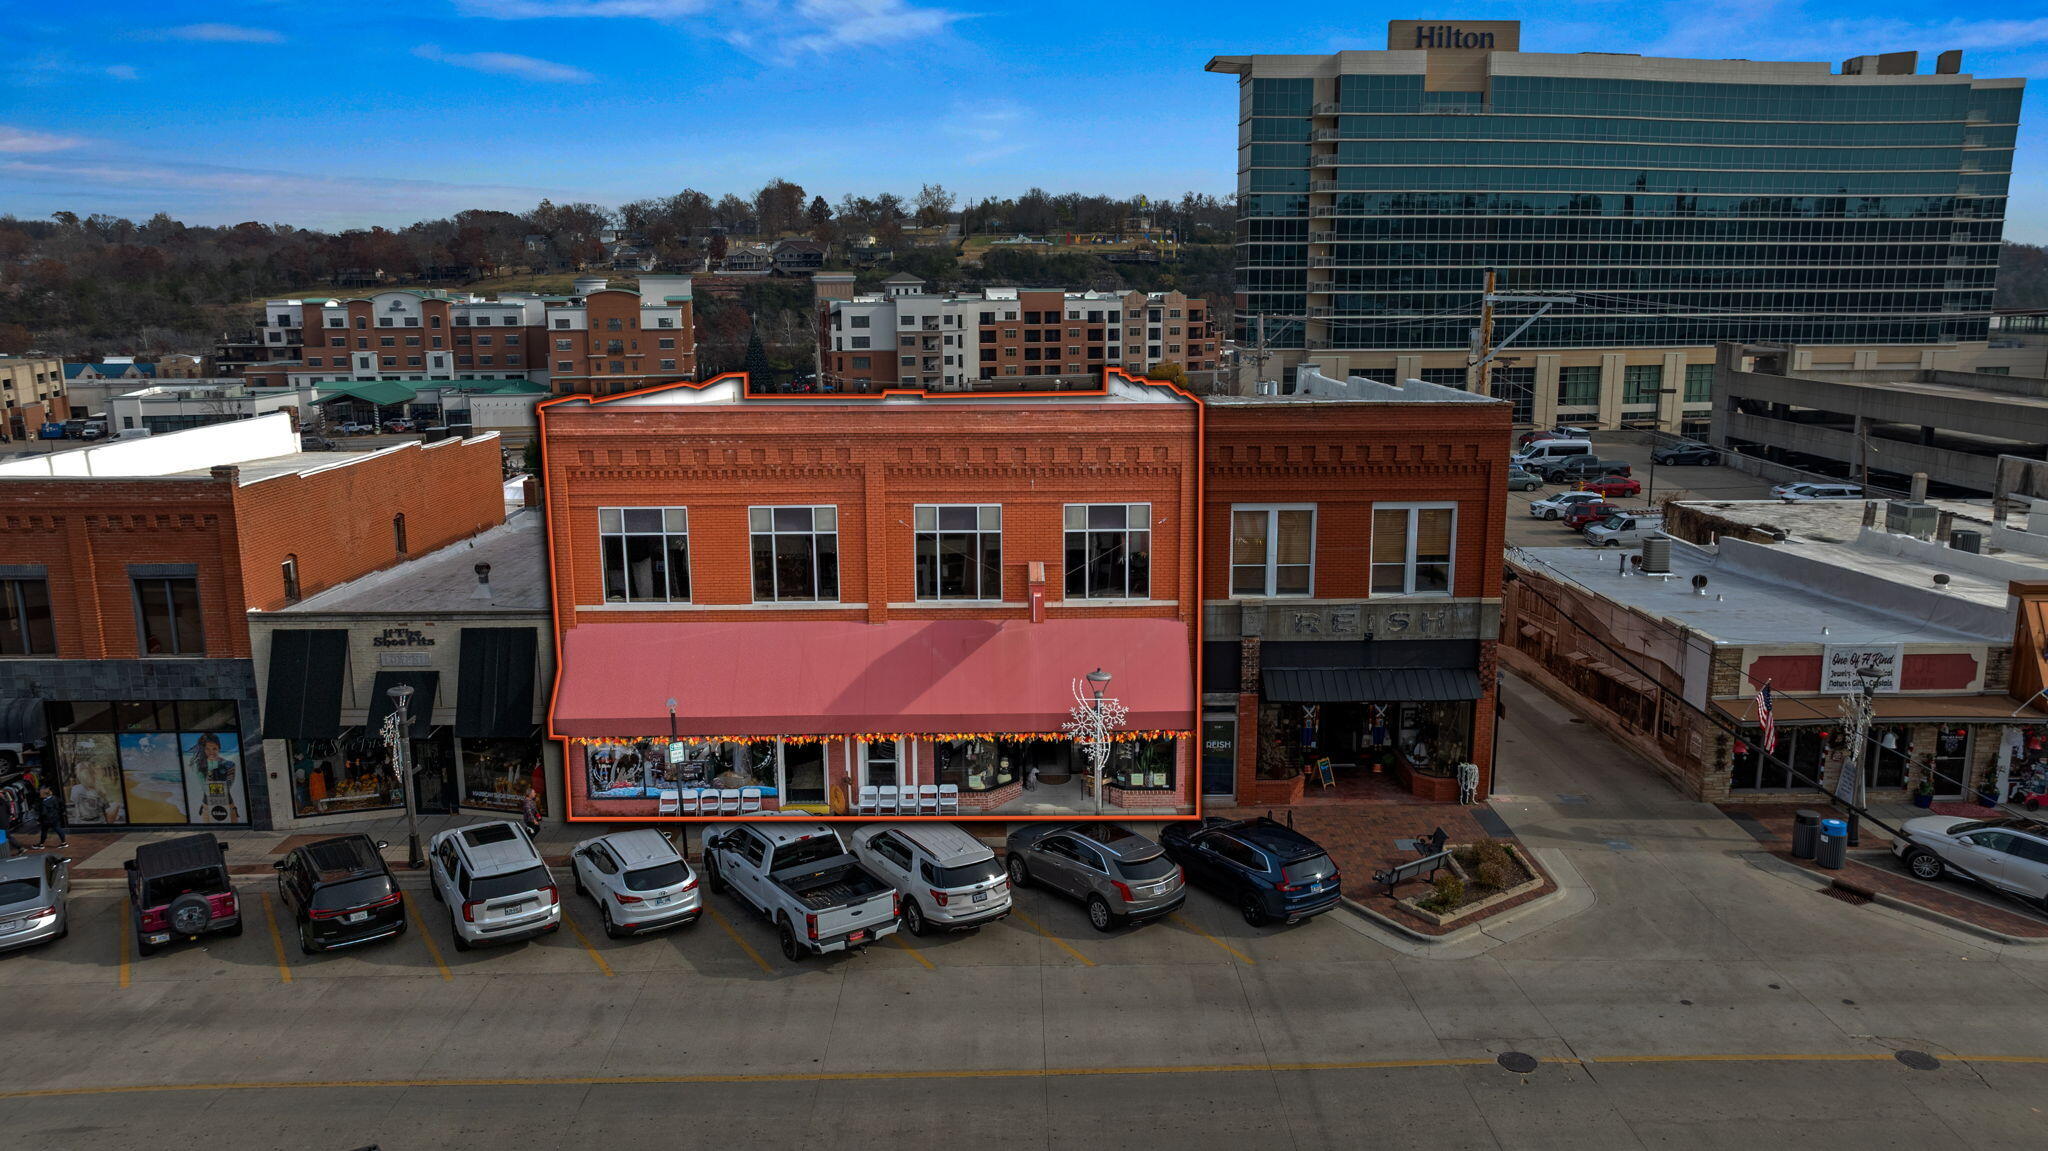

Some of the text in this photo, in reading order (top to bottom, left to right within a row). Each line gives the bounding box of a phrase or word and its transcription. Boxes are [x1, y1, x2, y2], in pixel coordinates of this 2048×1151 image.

[1415, 25, 1495, 49] Hilton
[1295, 610, 1446, 632] REISH
[373, 637, 407, 647] Shoe
[1832, 652, 1895, 668] One Of A Kind
[1206, 740, 1232, 748] REISH
